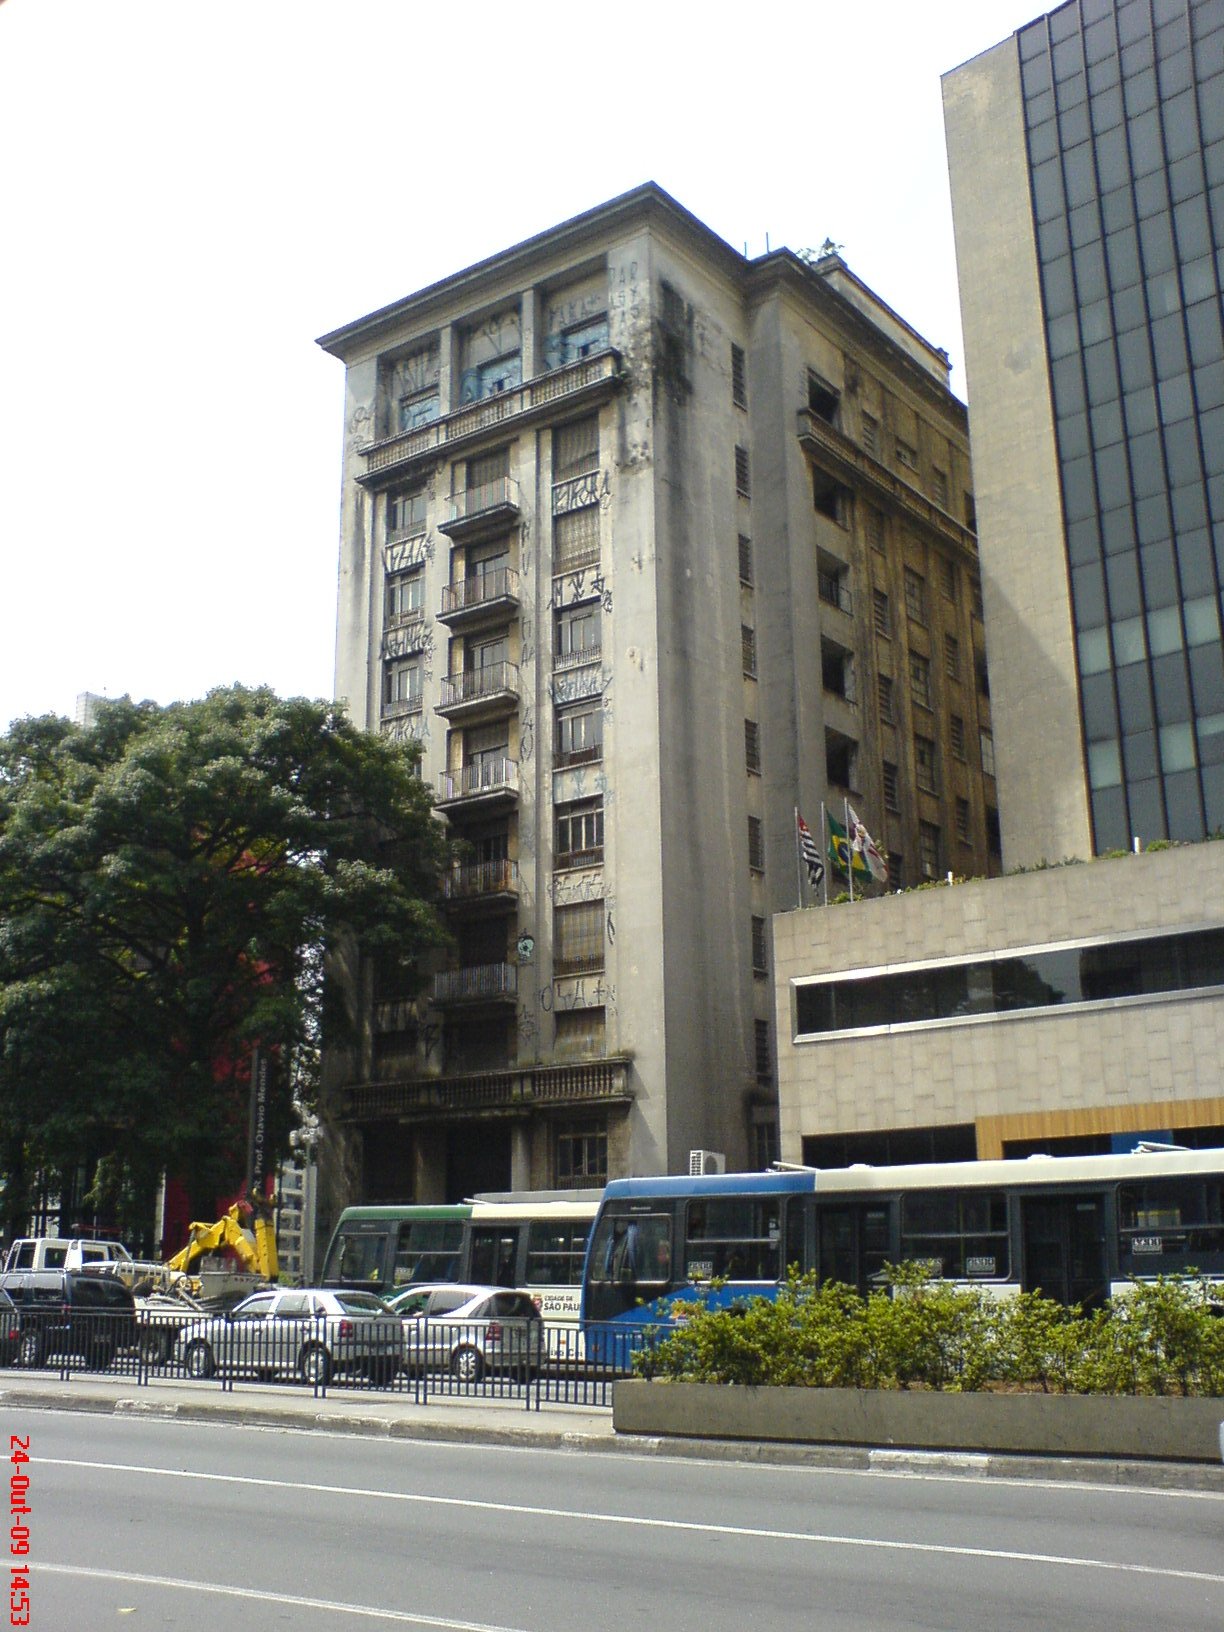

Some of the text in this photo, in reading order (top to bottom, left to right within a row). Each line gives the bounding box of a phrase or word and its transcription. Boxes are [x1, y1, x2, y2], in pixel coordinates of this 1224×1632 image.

[257, 1059, 266, 1102] Mendes
[254, 1147, 264, 1174] Prof.
[544, 1301, 580, 1311] SÃO PAU
